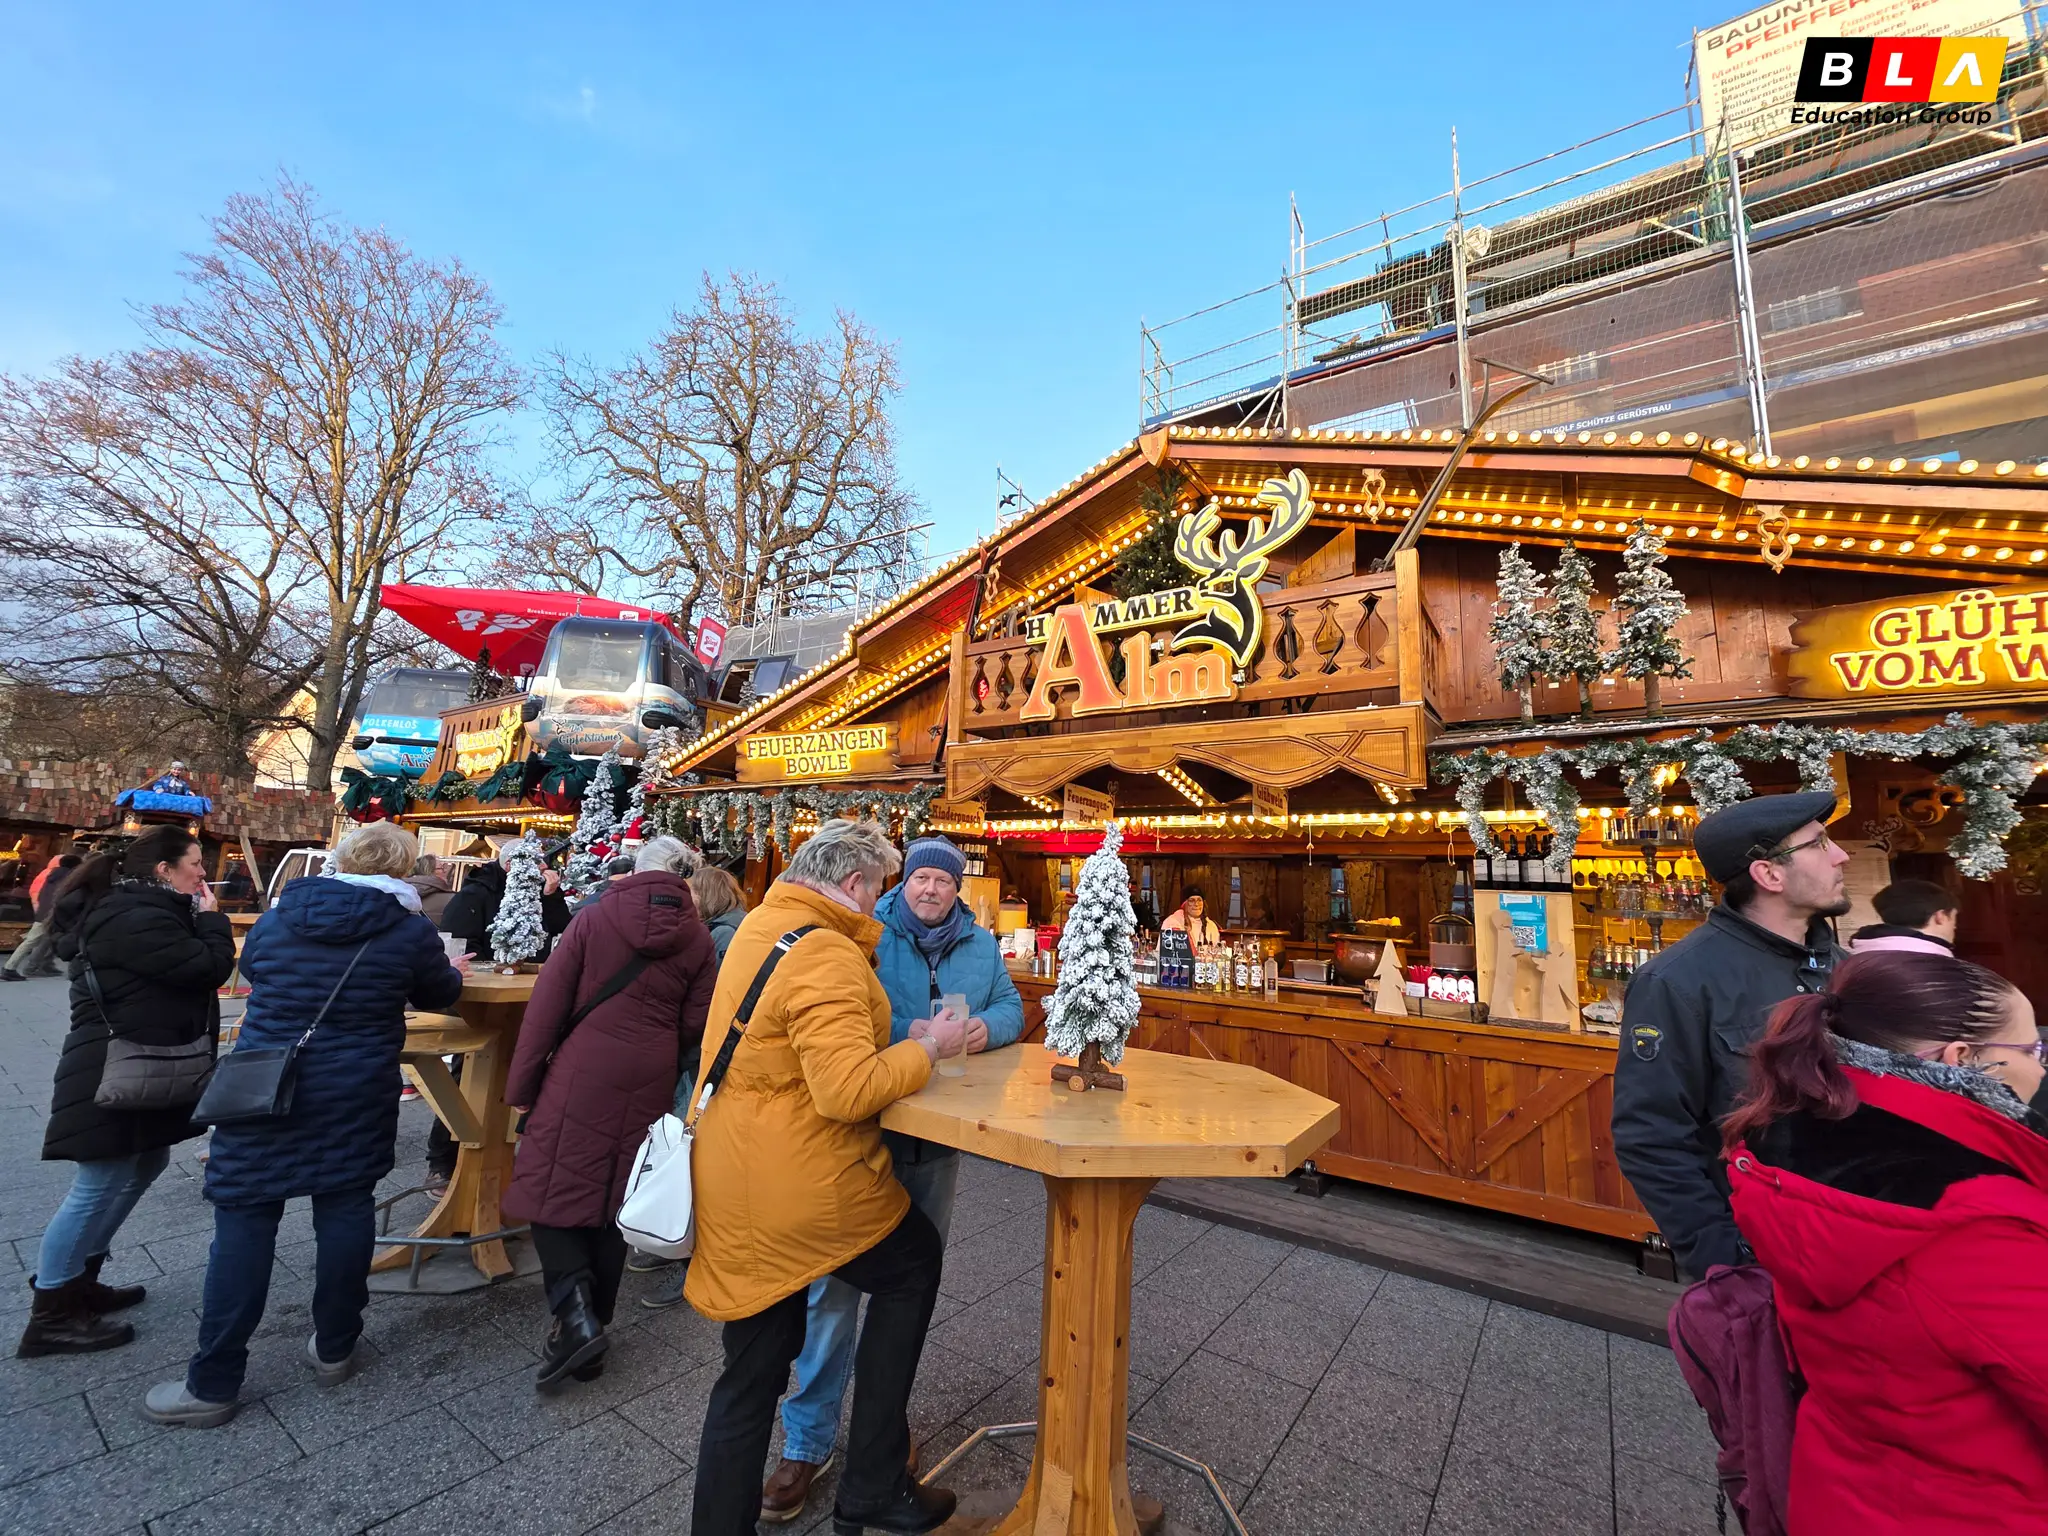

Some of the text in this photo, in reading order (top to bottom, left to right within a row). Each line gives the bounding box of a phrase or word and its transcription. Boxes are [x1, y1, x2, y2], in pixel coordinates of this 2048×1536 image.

[1711, 39, 1807, 80] Maurermeiste
[1722, 71, 1799, 103] Maurerarbeite
[1831, 194, 1874, 216] INGOLF
[1543, 403, 1672, 435] INGOLF SCHÜTZE GERÜSTBAU
[1019, 602, 1233, 720] Alm
[1834, 646, 1979, 689] VOM
[746, 728, 885, 758] FEUERZANGEN
[785, 753, 848, 775] BOWLE
[931, 803, 981, 825] Kinderpunsch
[1066, 789, 1110, 813] Feuerzangen-
